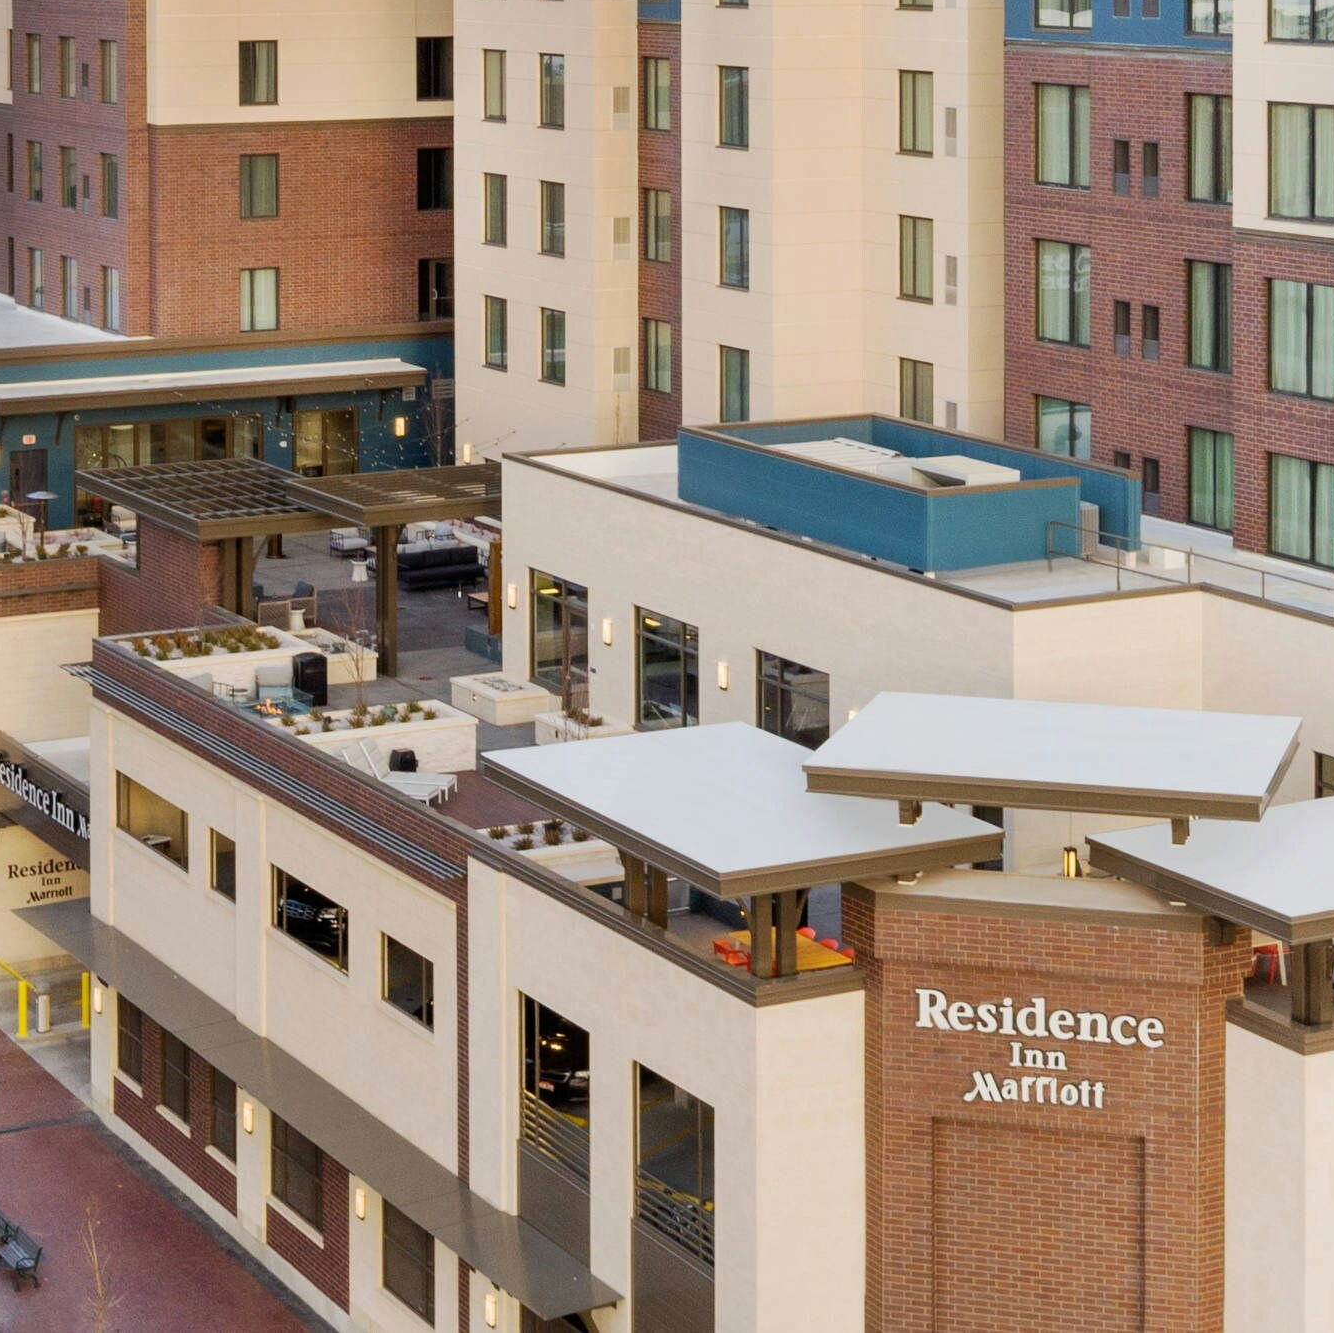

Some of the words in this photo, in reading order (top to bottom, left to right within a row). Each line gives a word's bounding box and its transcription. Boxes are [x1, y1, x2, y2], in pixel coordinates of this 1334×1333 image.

[51, 790, 75, 832] Inn
[8, 859, 81, 879] Residen
[41, 876, 62, 886] Inn
[27, 886, 73, 904] Marriott
[915, 988, 1165, 1048] Residence
[1009, 1042, 1067, 1071] Inn
[962, 1070, 1106, 1109] Marriott
